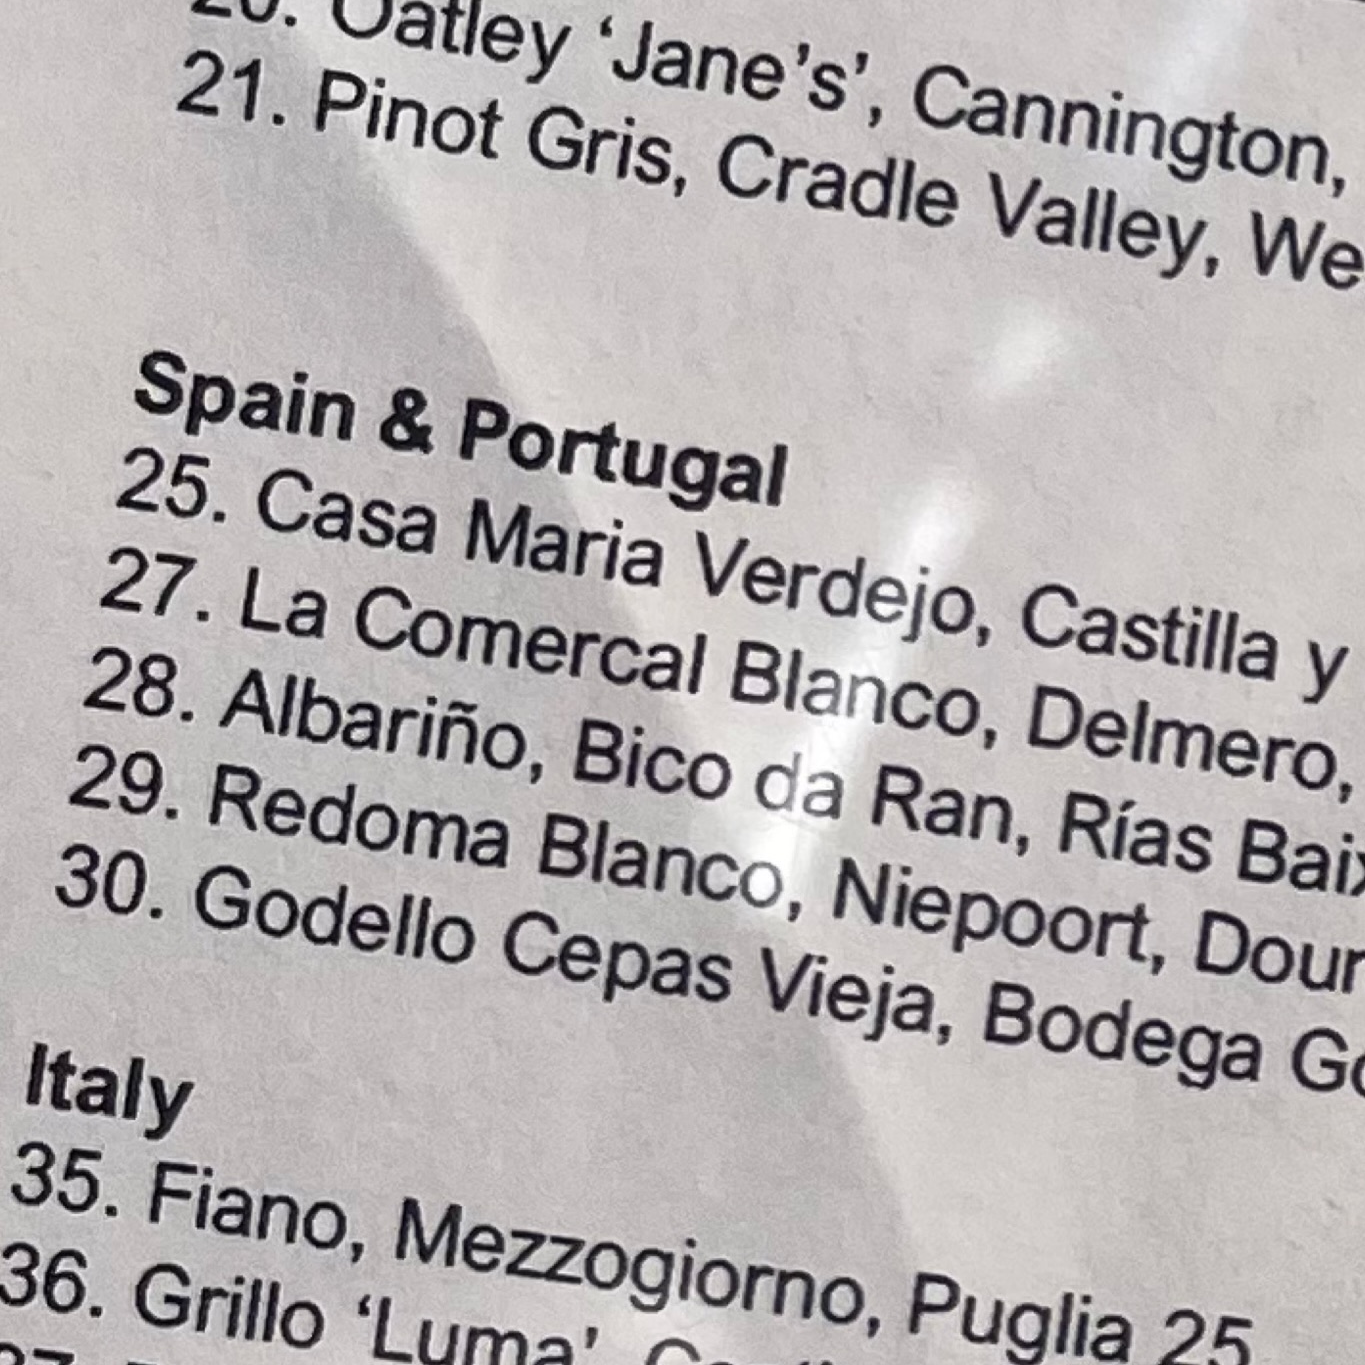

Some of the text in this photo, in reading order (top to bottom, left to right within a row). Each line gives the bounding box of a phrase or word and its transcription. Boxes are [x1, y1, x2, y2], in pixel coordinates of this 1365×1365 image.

[176, 49, 285, 126] 21.
[314, 68, 504, 159] Pinot
[528, 105, 686, 197] Gris,
[718, 133, 959, 228] Cradle
[988, 171, 1219, 280] Valley,
[600, 15, 882, 128] ‘Jane’s’,
[914, 65, 1345, 198] Cannington,
[134, 350, 788, 512] Spain & Portugal
[99, 546, 209, 622] 27.
[240, 566, 327, 639] La
[355, 586, 707, 694] Comercal
[730, 640, 997, 750] Blanco,
[1028, 684, 1352, 804] Delmero,
[115, 447, 226, 523] 25.
[257, 468, 437, 554] Casa
[465, 498, 663, 587] Maria
[696, 530, 990, 648] Verdejo,
[1022, 583, 1278, 681] Castilla
[1302, 640, 1349, 704] y
[68, 744, 178, 820] 29.
[208, 763, 509, 868] Redoma
[538, 812, 801, 922] Blanco,
[832, 857, 1165, 976] Niepoort,
[83, 646, 193, 722] 28.
[218, 668, 543, 784] Albariño,
[573, 717, 732, 800] Bico
[754, 752, 843, 819] da
[871, 764, 1029, 857] Ran,
[1058, 790, 1212, 873] Rías
[55, 843, 163, 919] 30.
[195, 865, 476, 964] Godello
[503, 910, 732, 1003] Cepas
[761, 947, 952, 1045] Vieja,
[983, 981, 1262, 1091] Bodega
[26, 1042, 195, 1141] Italy
[0, 1241, 103, 1316] 36.
[134, 1263, 325, 1349] Grillo
[11, 1141, 1253, 1365] 35. Fiano, Mezzogiorno, Puglia 25
